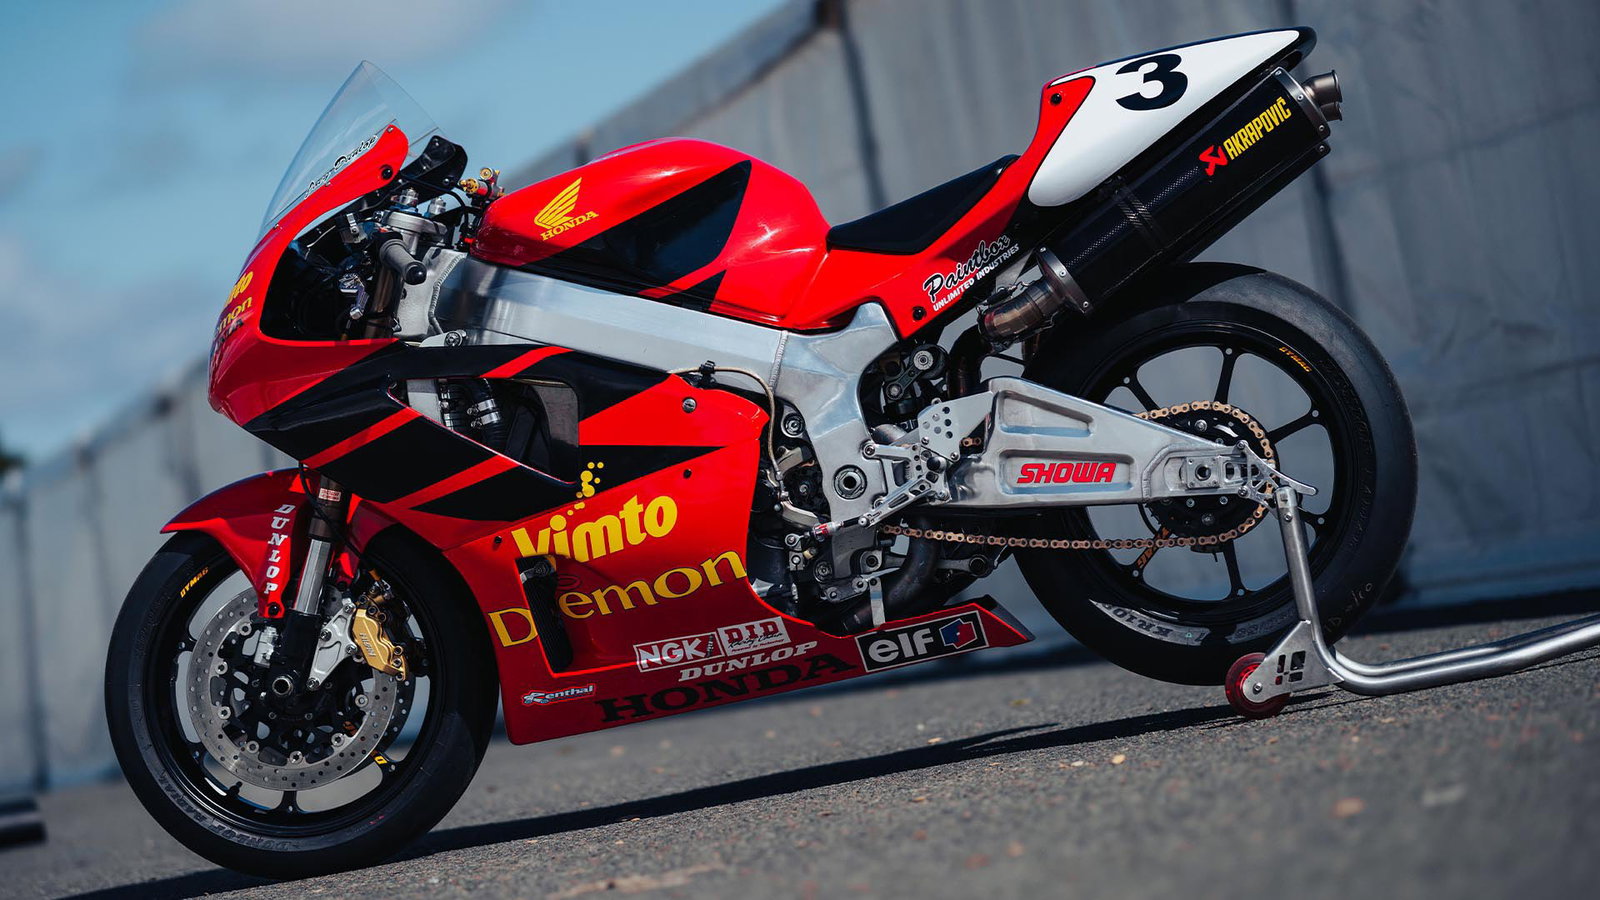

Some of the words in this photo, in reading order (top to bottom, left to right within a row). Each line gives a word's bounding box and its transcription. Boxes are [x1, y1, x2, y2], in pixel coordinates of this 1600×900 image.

[1115, 53, 1188, 111] 3
[540, 211, 599, 241] HONDA
[922, 235, 1011, 303] Paintbox
[932, 278, 975, 312] UNLIMITED
[976, 243, 1020, 280] INDUSTRIES
[1017, 462, 1117, 484] SHOWA
[264, 504, 296, 594] DUNLOP
[511, 495, 678, 564] Vimto
[638, 638, 706, 669] NGK
[724, 621, 780, 645] DID
[868, 628, 934, 663] elf
[678, 641, 818, 682] DUNLOP
[595, 653, 858, 722] HONDA
